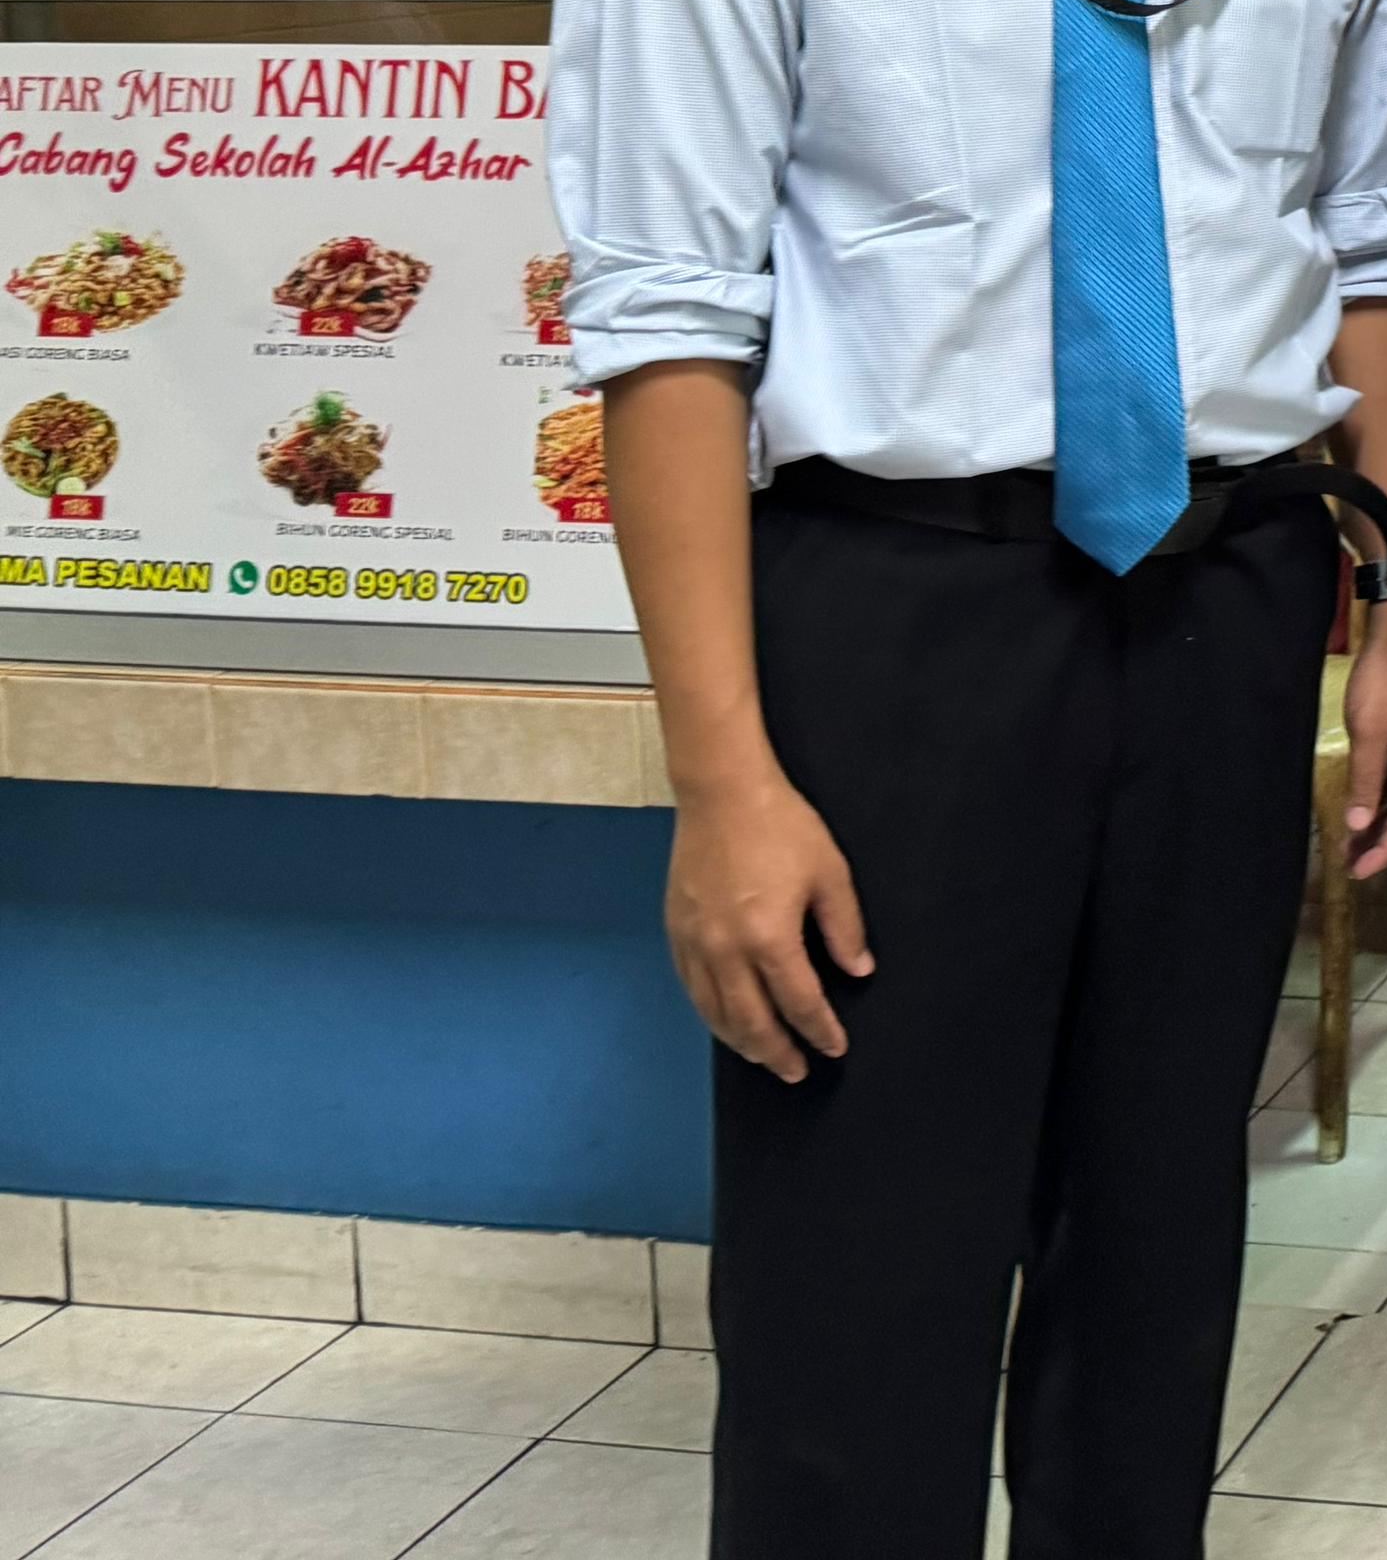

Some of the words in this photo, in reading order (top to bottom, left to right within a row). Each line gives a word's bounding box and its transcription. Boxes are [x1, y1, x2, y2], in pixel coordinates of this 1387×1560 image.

[112, 69, 235, 121] MENU
[254, 58, 471, 120] KANTIN
[0, 131, 137, 193] Cabang
[155, 132, 315, 179] Sekolah
[332, 134, 531, 182] Al-Azhar
[253, 343, 330, 357] KWETIAW
[333, 344, 396, 359] SPESIAL
[276, 522, 326, 537] BIHUN
[328, 524, 392, 540] GORENG
[394, 526, 455, 542] SPESIAL
[501, 527, 554, 543] BIHUN
[556, 529, 618, 545] GOREN
[54, 557, 213, 592] PESANAN
[267, 566, 348, 598] 0858
[355, 570, 439, 602] 9918
[446, 573, 529, 604] 7270
